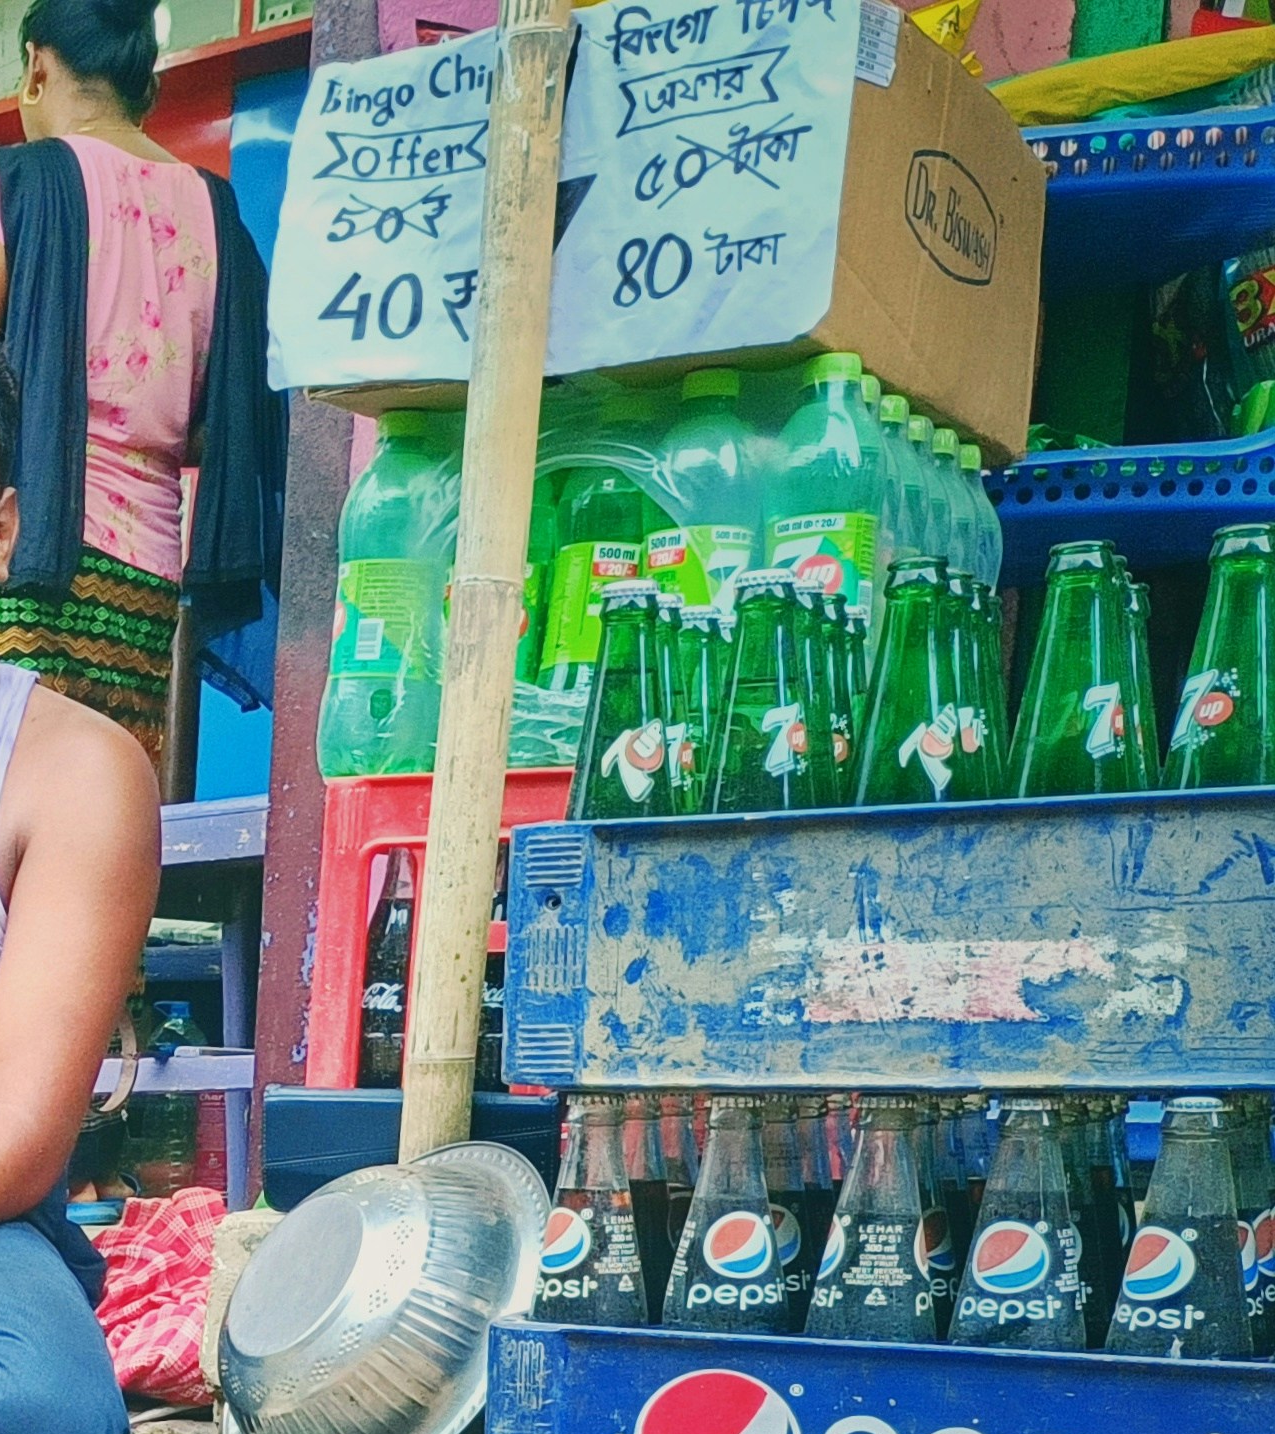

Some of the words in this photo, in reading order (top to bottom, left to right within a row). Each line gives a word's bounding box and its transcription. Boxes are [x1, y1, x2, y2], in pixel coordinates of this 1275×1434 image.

[351, 136, 464, 177] Offer
[703, 227, 787, 275] টাকা
[599, 547, 622, 559] 500
[858, 1225, 904, 1234] LEHAR
[859, 1234, 901, 1243] PEPSI
[687, 1277, 783, 1311] pepsi
[958, 1294, 1055, 1325] pepsi
